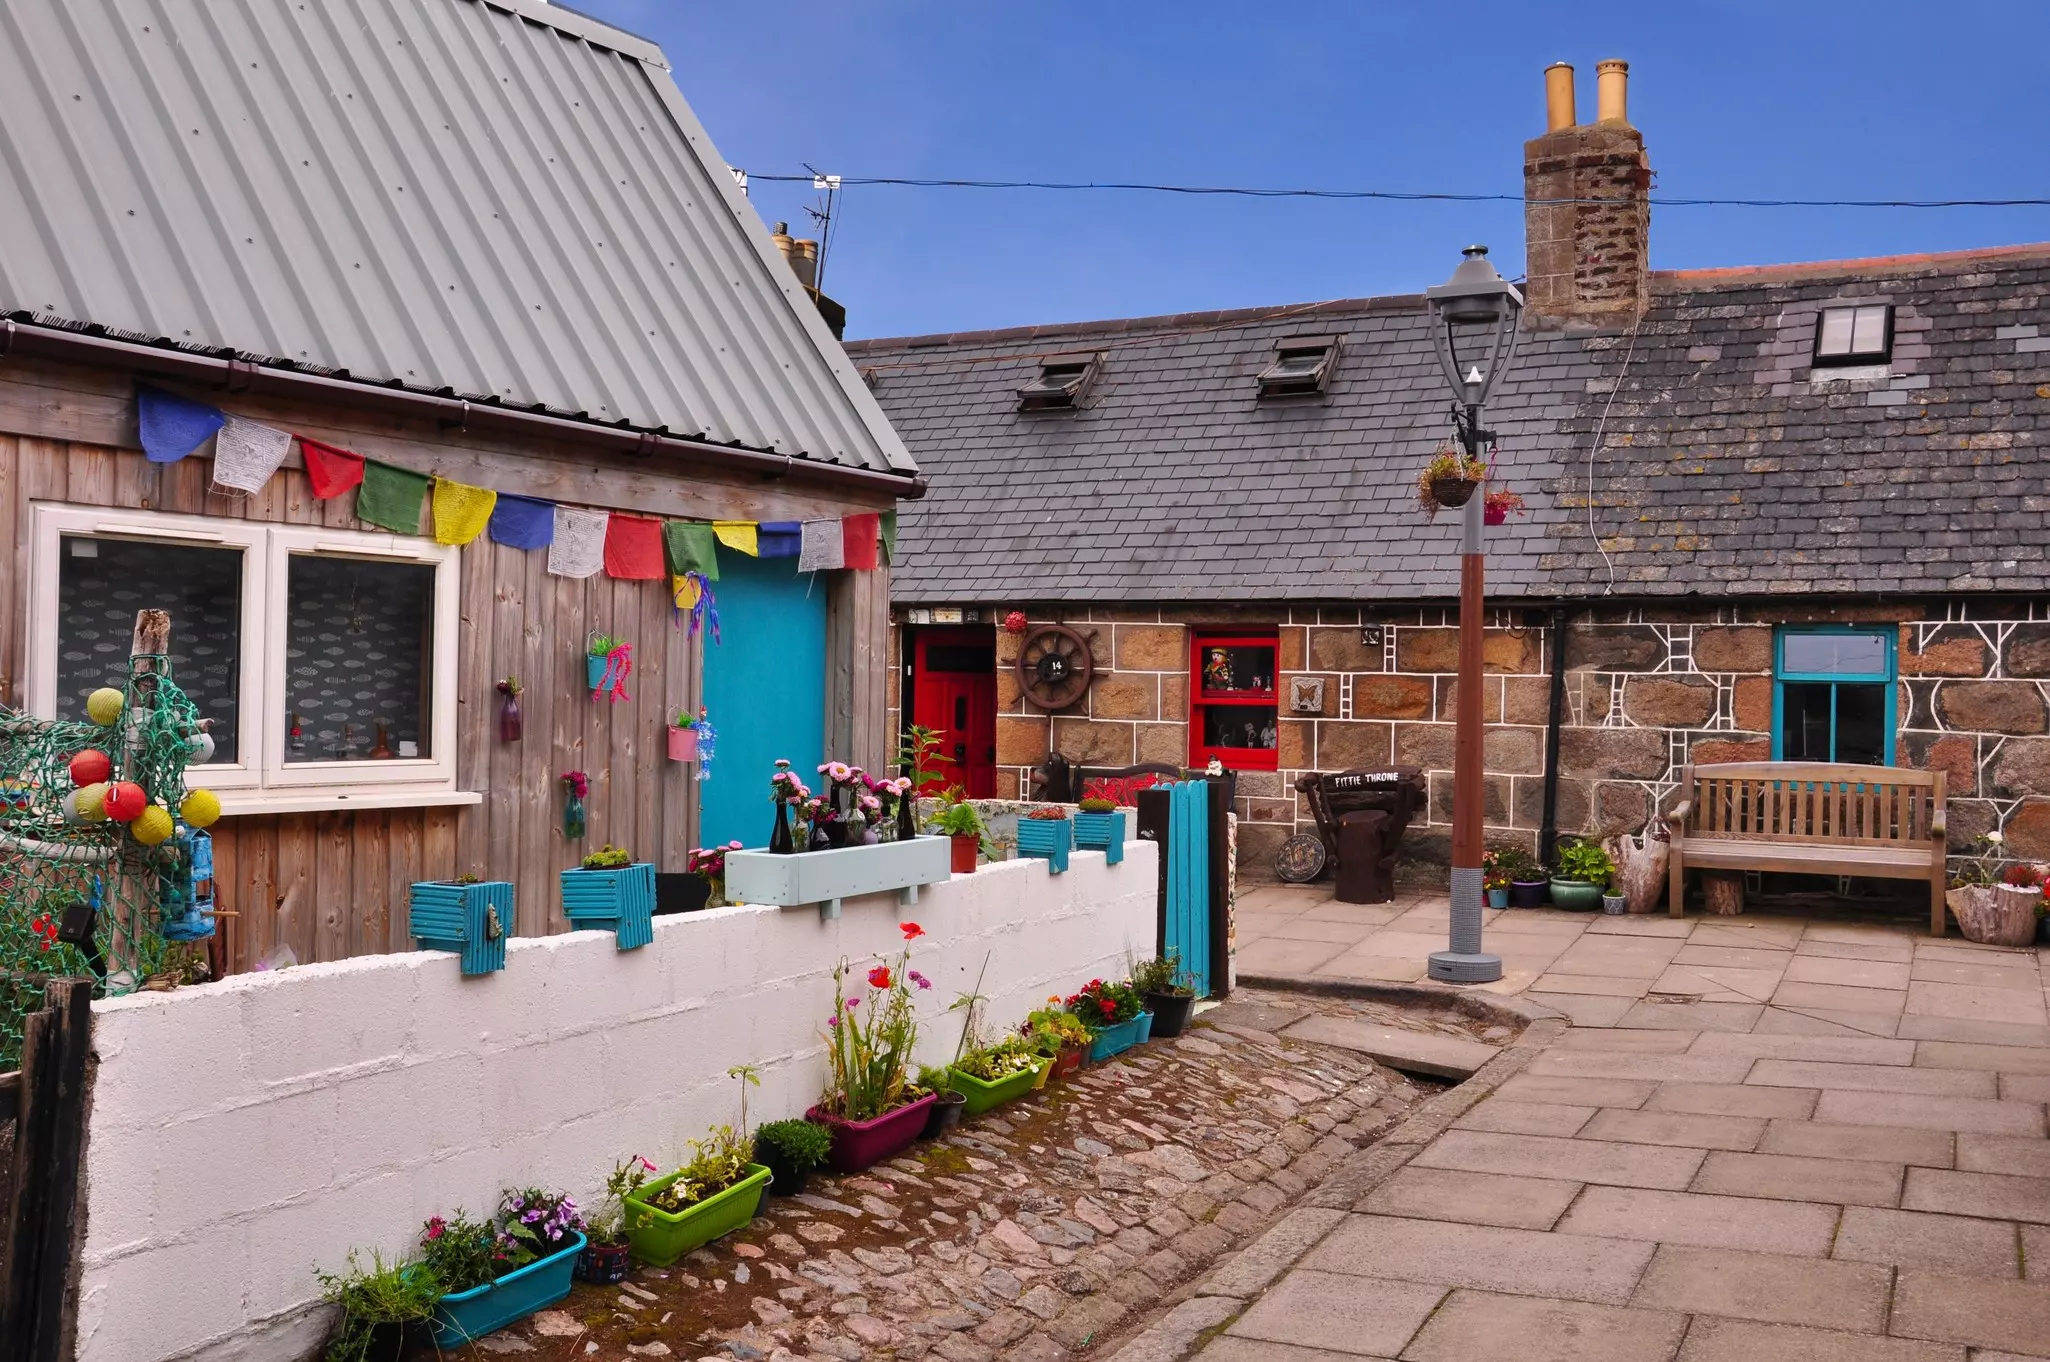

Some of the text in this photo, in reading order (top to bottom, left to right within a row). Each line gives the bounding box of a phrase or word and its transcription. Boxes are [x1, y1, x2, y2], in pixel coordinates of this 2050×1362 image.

[1052, 661, 1062, 670] 14
[1335, 772, 1399, 787] FITTIE THRONE
